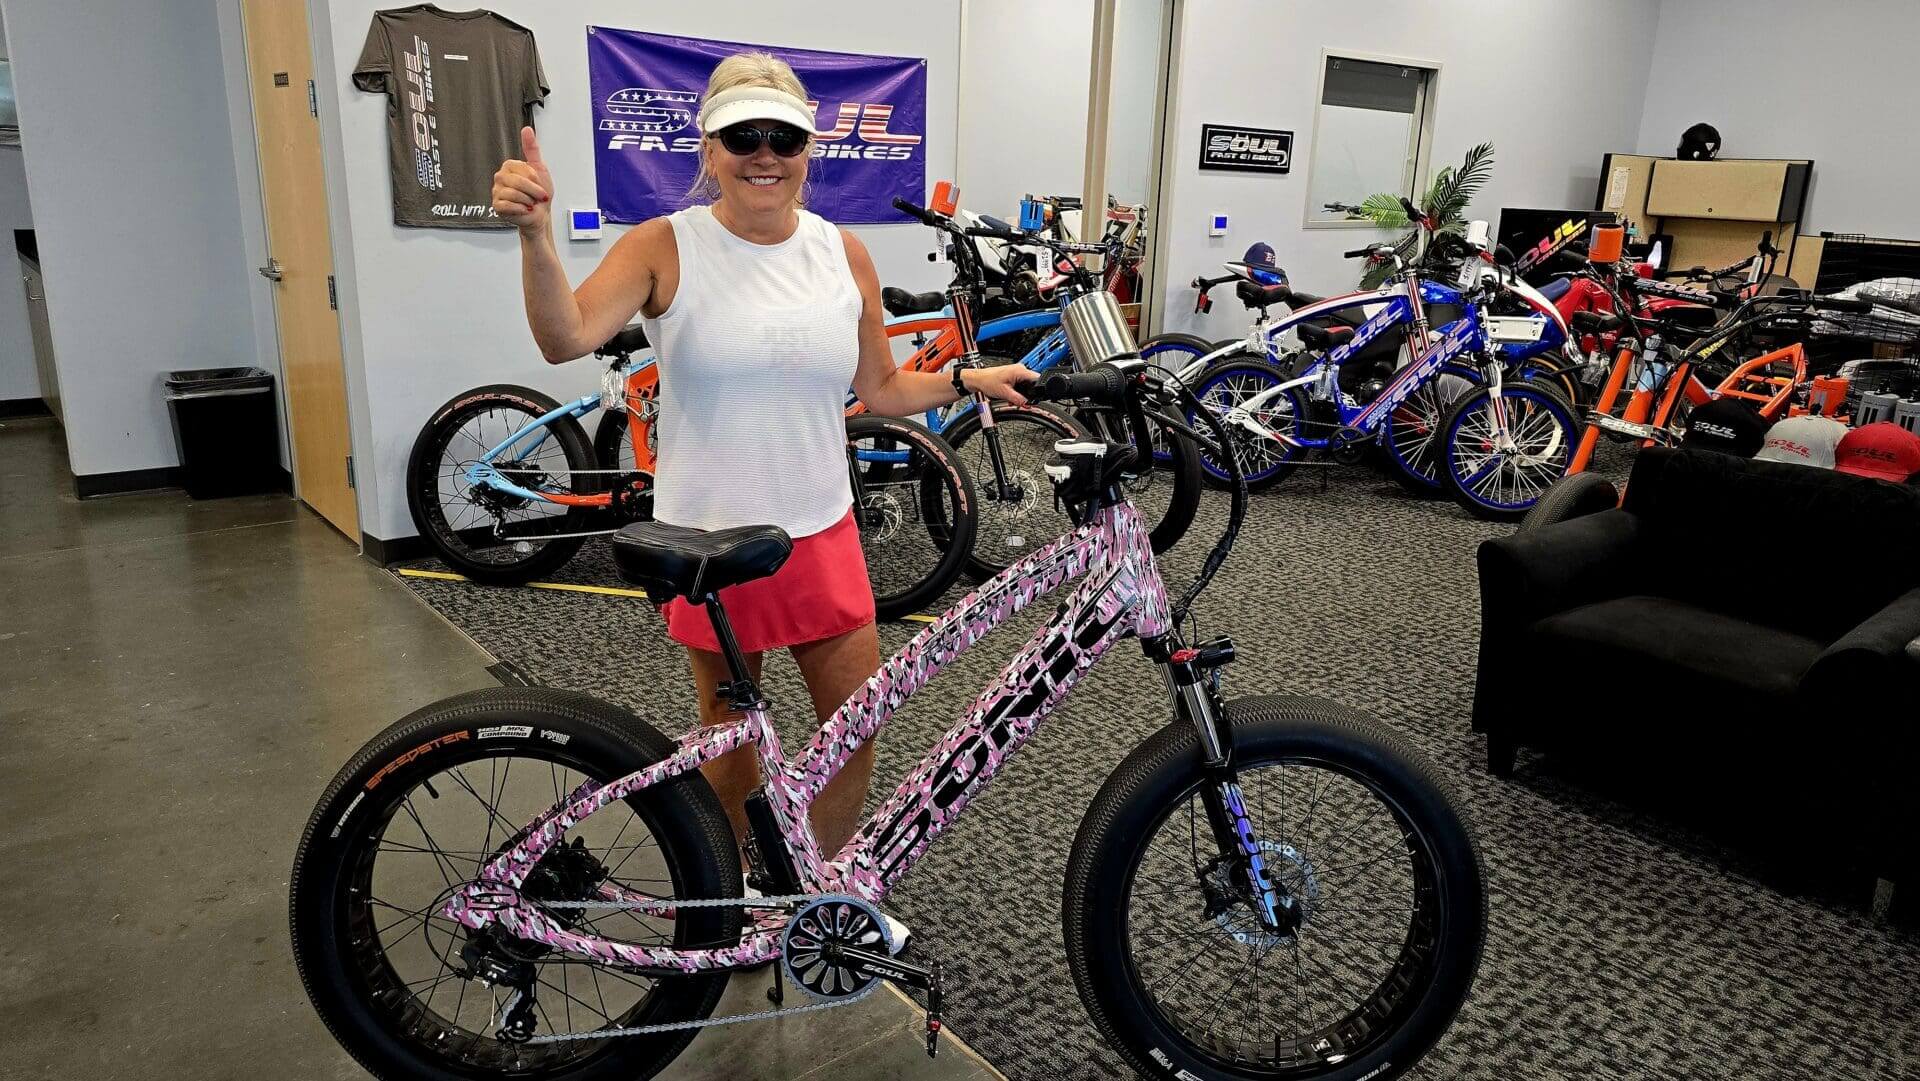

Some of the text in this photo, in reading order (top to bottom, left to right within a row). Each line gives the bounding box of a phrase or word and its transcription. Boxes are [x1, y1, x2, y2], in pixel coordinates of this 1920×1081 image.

[420, 40, 434, 102] BIKES
[599, 88, 922, 144] SUL
[430, 136, 443, 189] FAST
[608, 135, 700, 152] FAS
[1210, 151, 1239, 160] FAST
[431, 204, 459, 217] ROLL
[460, 204, 484, 217] WITH
[873, 565, 1138, 882] SONIC
[364, 729, 471, 791] SPEEDSTER
[862, 963, 908, 981] SOUL
